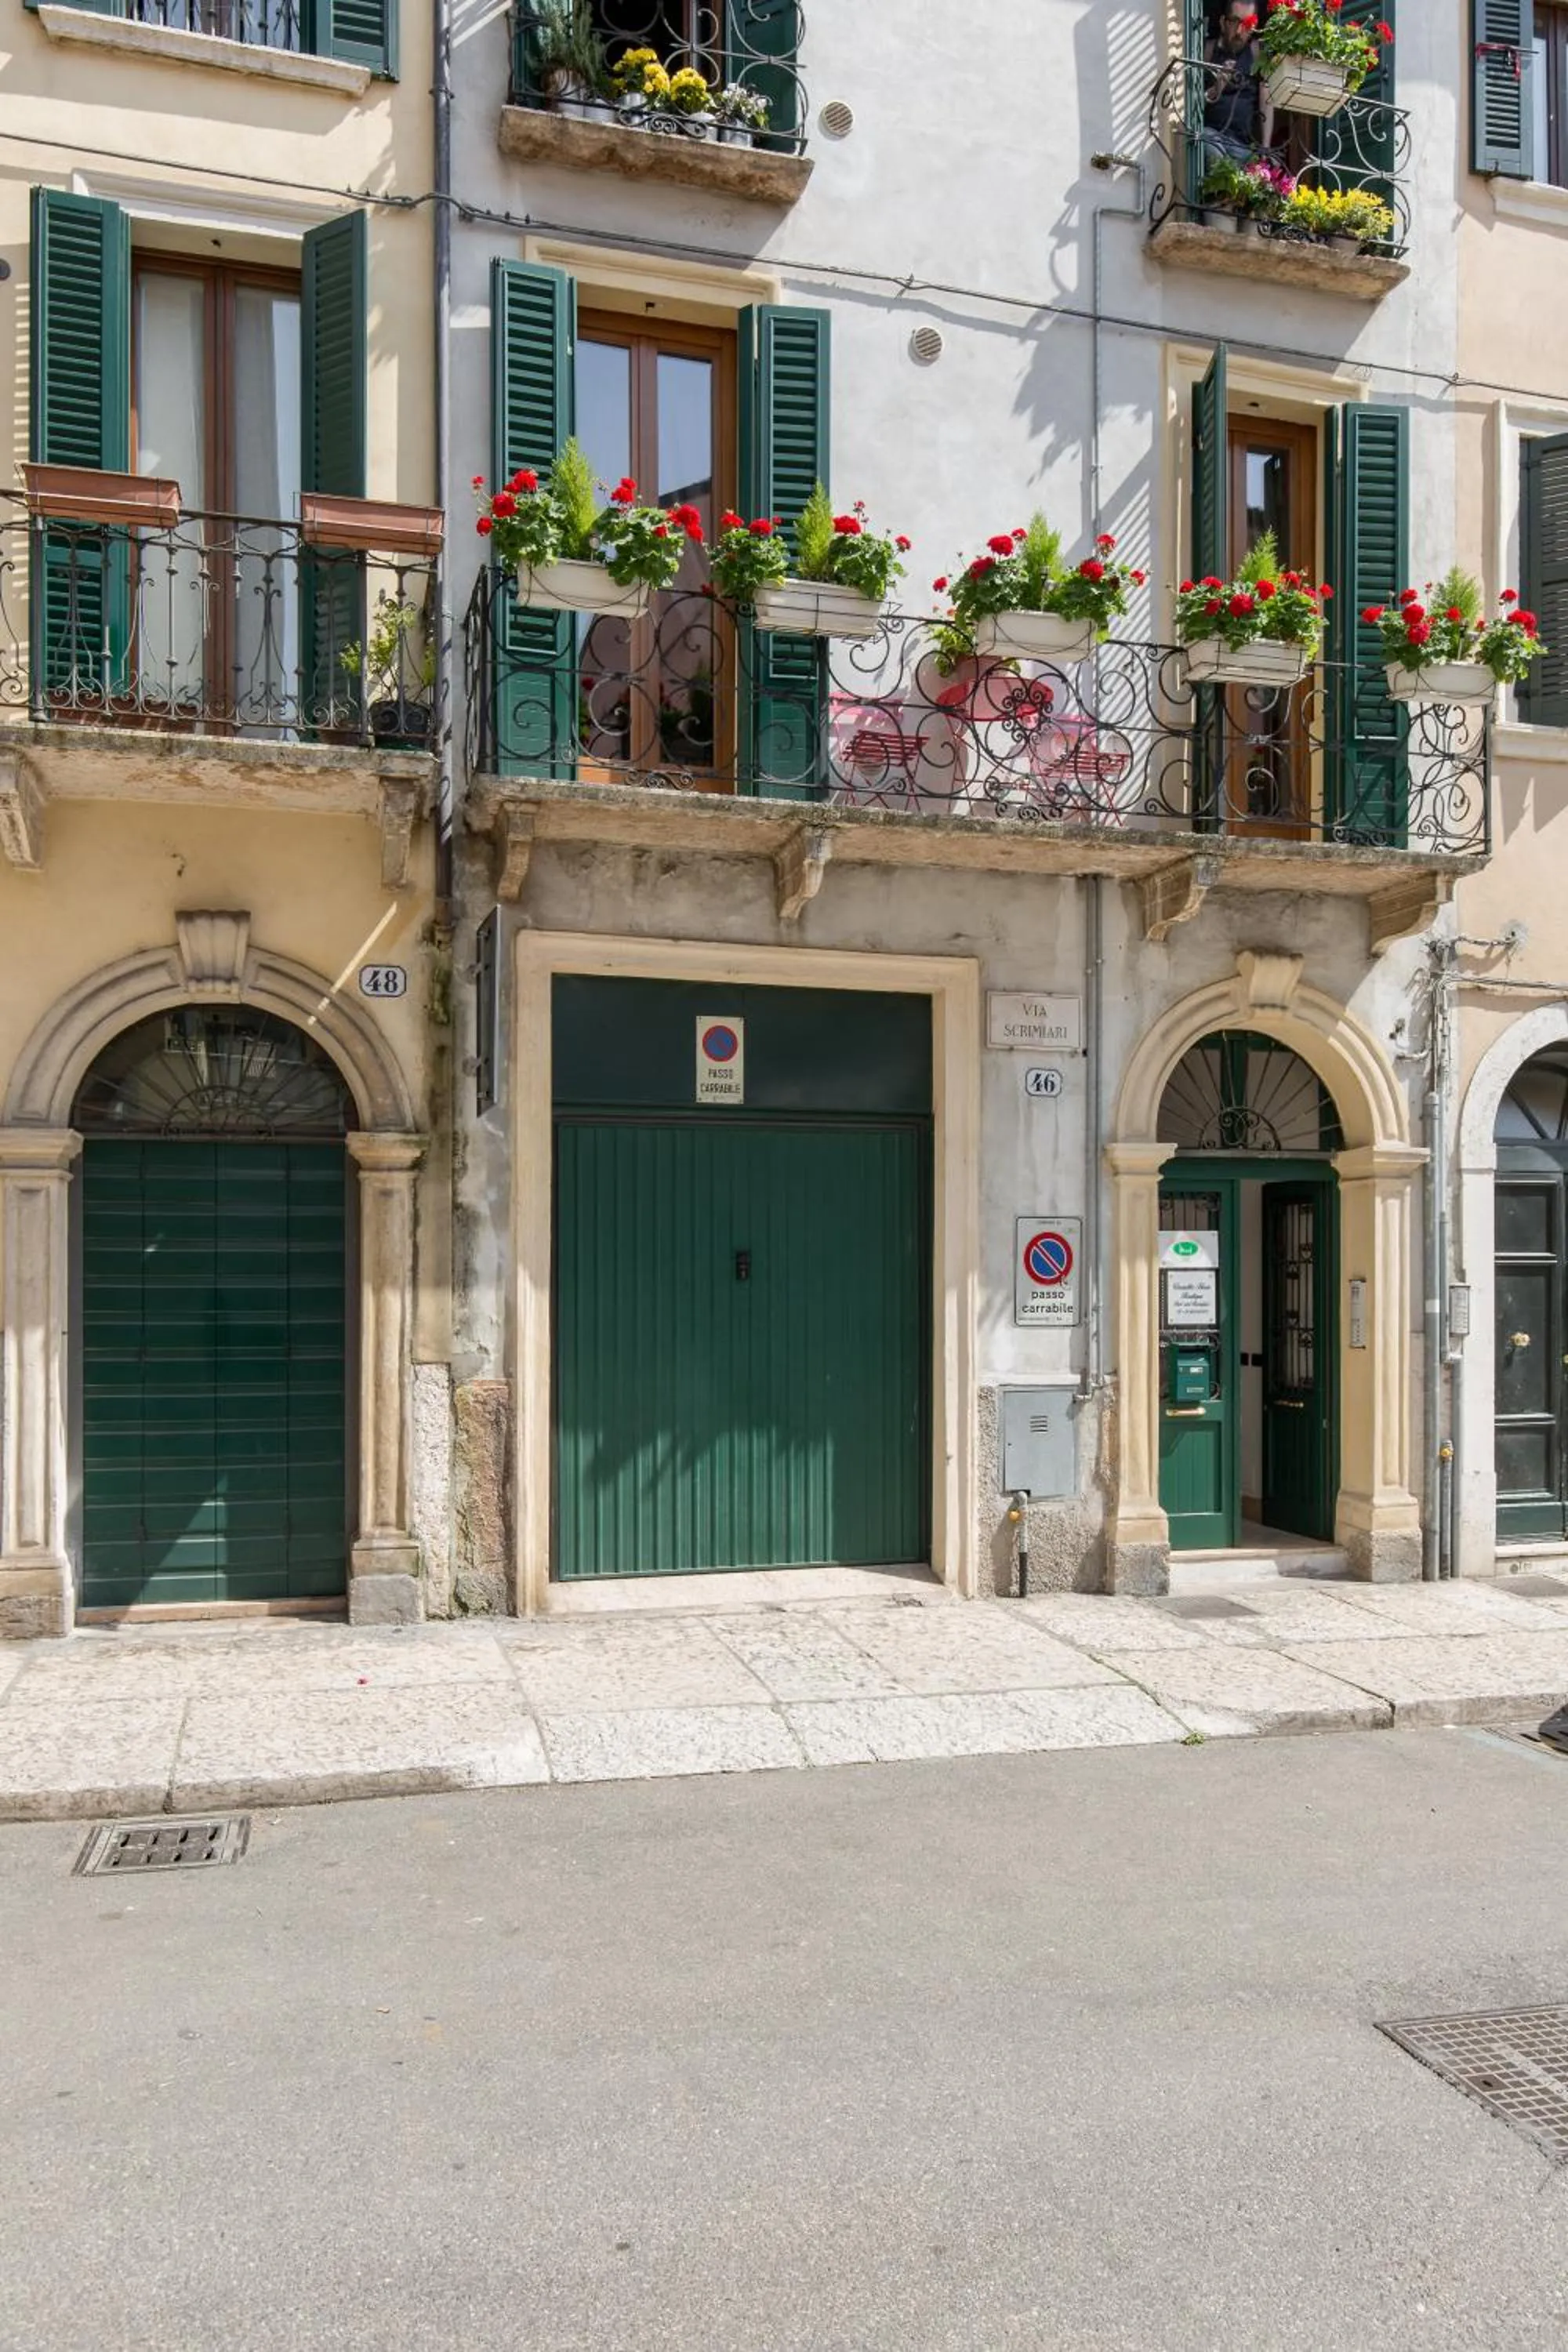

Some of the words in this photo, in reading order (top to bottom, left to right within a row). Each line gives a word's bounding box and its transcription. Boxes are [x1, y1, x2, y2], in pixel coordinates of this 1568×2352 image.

[365, 970, 398, 993] 48
[1022, 1003, 1047, 1017] VIA
[1004, 1023, 1067, 1039] SCRIMIARI
[1031, 1073, 1056, 1093] 46
[1031, 1290, 1065, 1301] passo
[1022, 1302, 1073, 1314] carrabile
